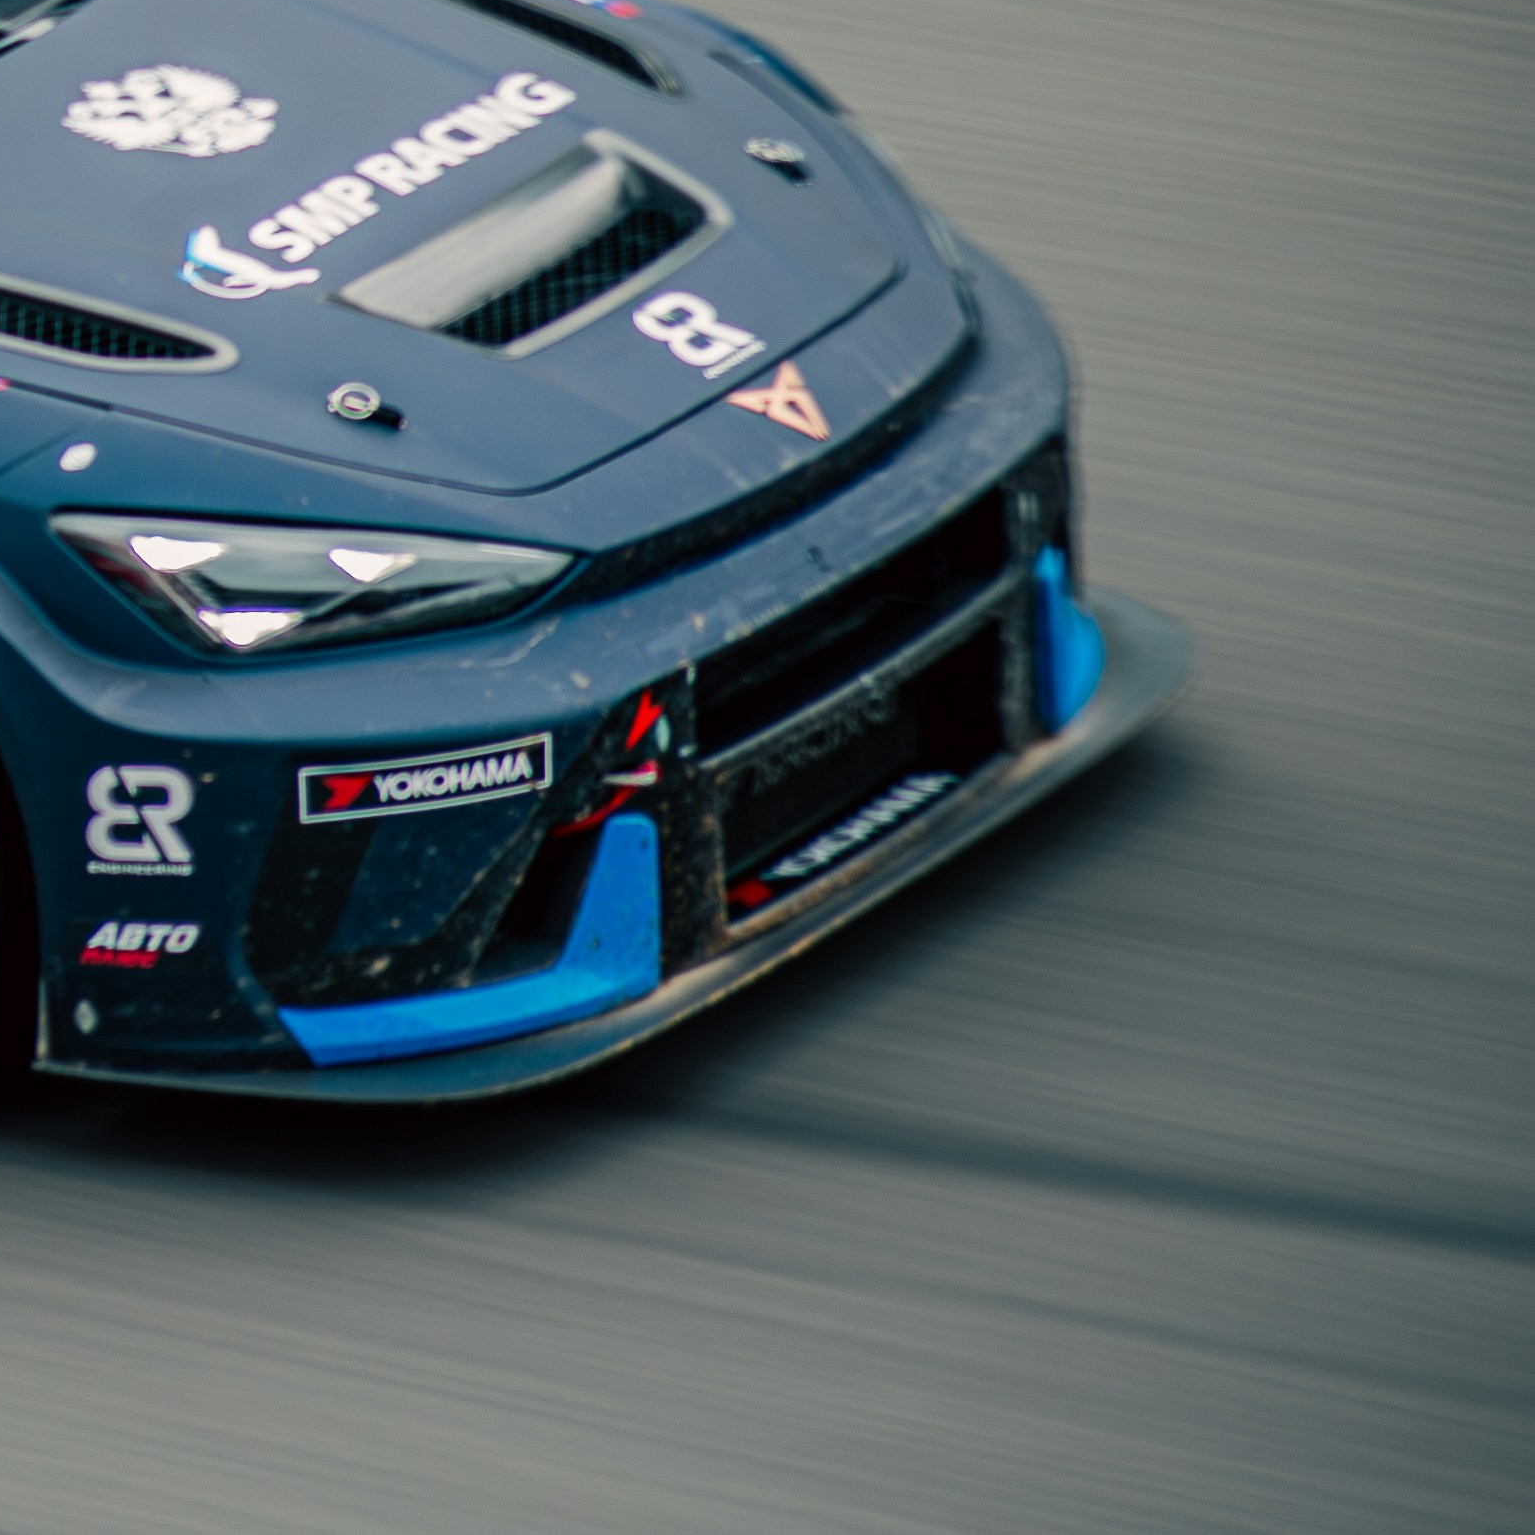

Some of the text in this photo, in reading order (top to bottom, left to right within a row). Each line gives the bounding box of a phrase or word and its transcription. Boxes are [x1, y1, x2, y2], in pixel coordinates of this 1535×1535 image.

[248, 72, 577, 263] SMP RACING
[374, 751, 533, 805] YOKOHAMA
[87, 921, 202, 954] АВТО
